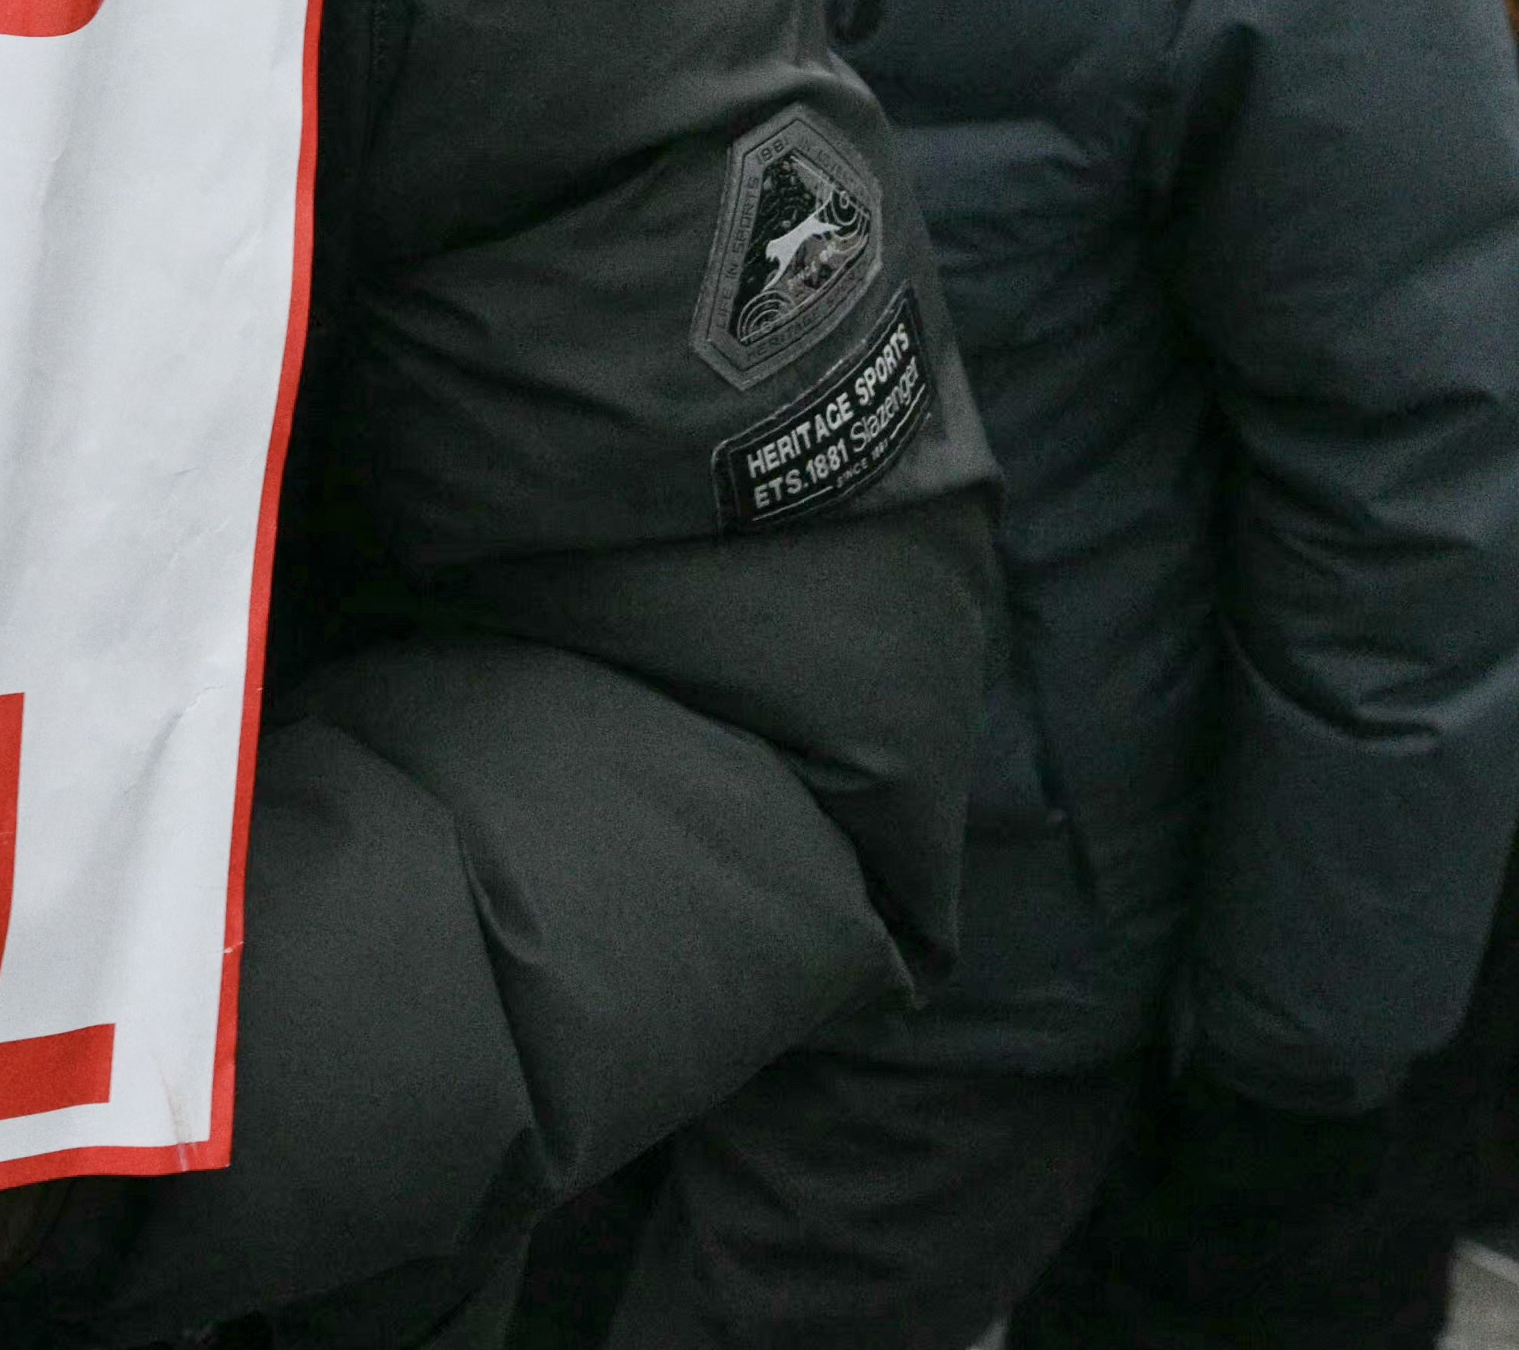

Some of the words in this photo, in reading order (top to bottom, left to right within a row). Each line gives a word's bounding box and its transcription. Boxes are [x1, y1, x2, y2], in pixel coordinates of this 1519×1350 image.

[746, 392, 855, 479] HERITAGE
[854, 323, 909, 406] SPORTS
[849, 356, 918, 453] Slazenger
